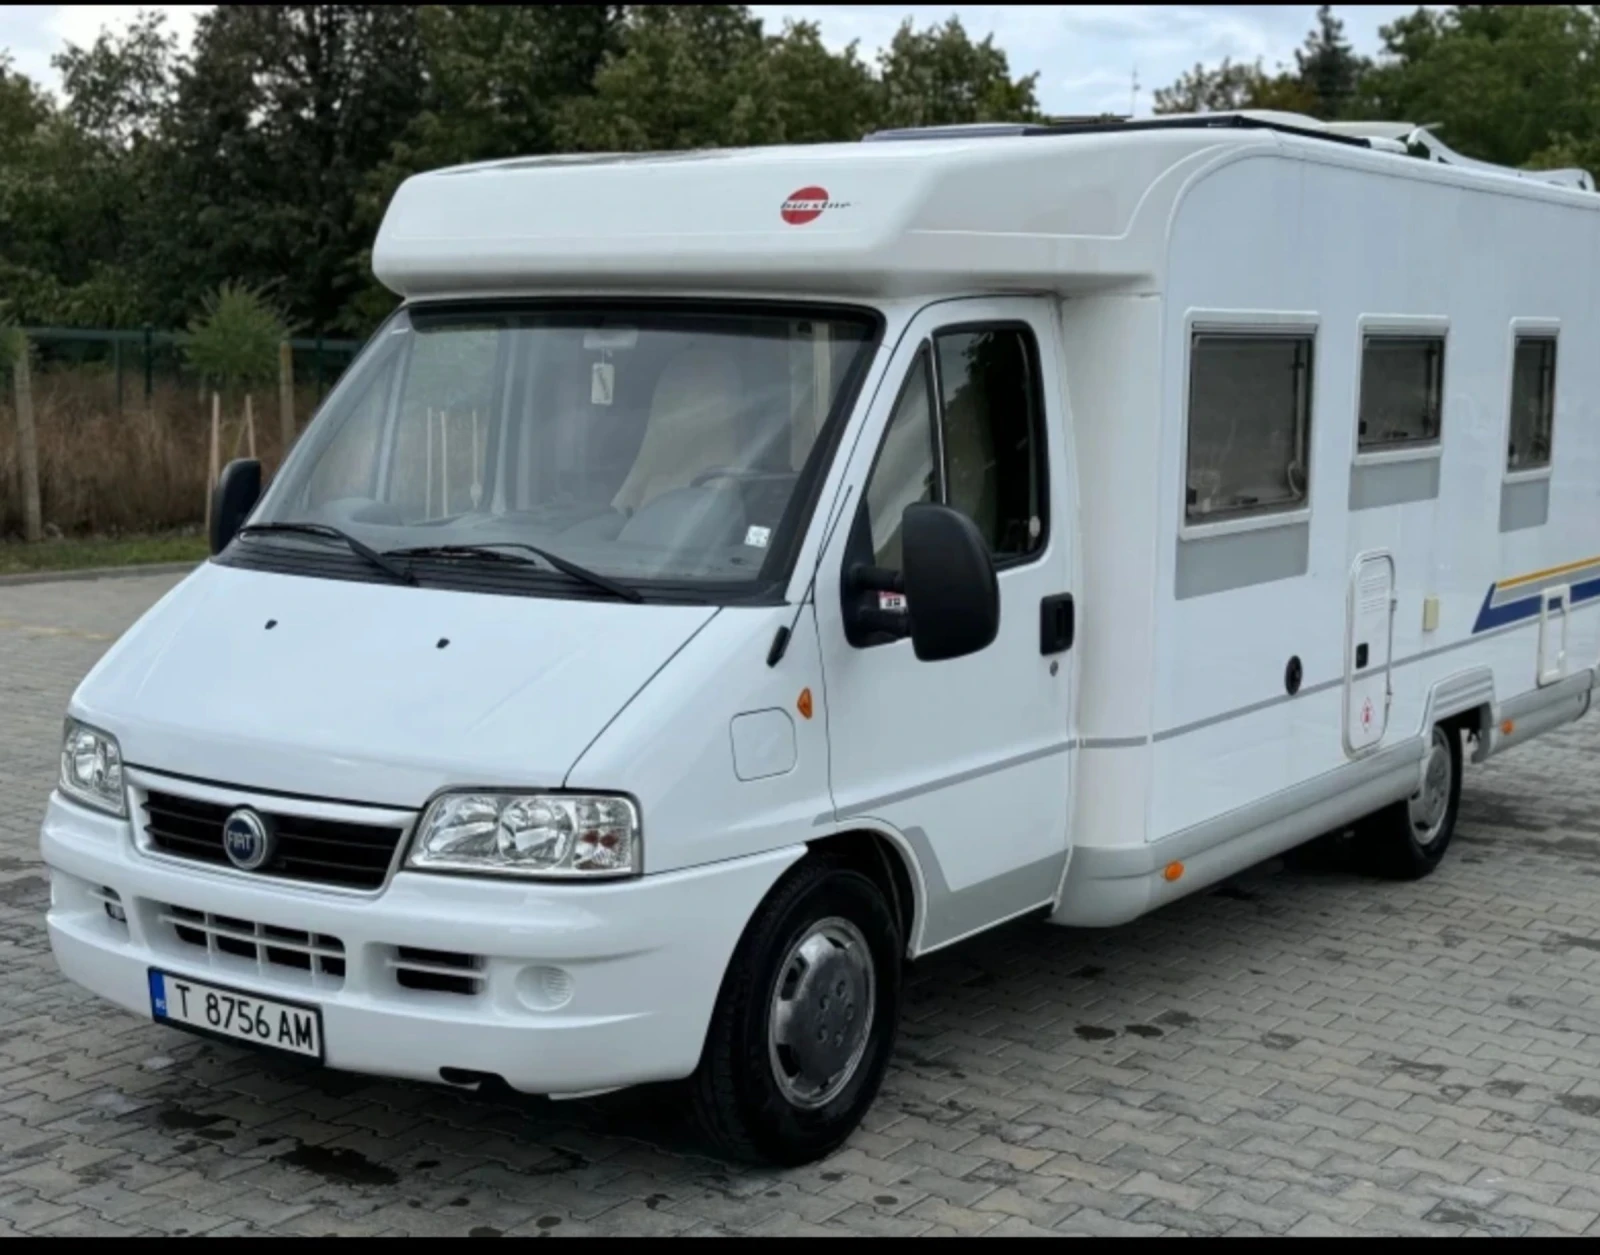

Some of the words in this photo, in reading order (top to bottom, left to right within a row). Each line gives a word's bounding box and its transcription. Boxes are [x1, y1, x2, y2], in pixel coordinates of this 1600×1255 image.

[227, 830, 253, 851] FIAT
[175, 983, 190, 1018] T
[205, 992, 271, 1039] 8756
[278, 1010, 313, 1051] AM
